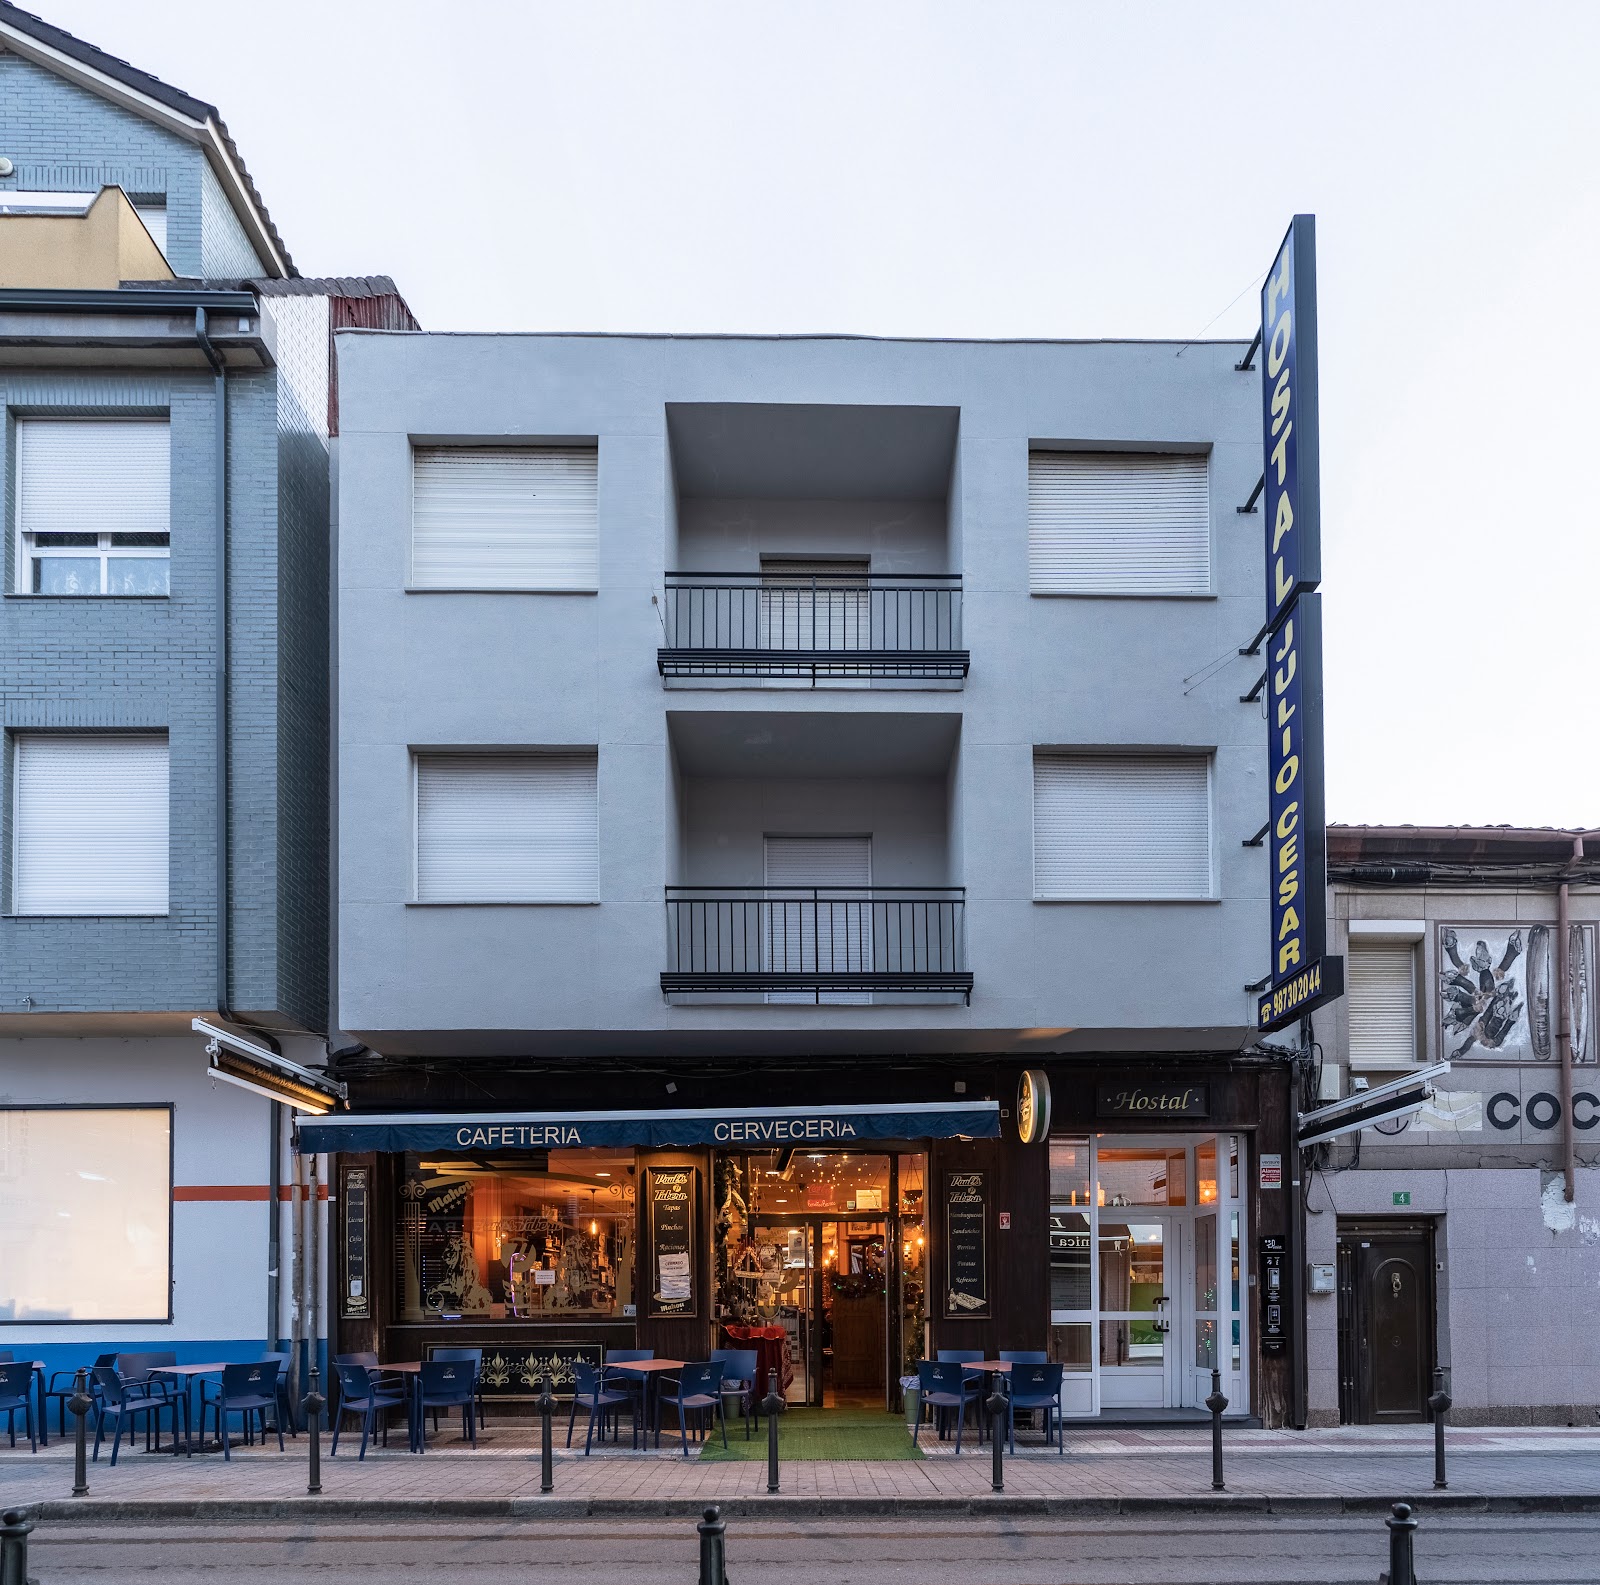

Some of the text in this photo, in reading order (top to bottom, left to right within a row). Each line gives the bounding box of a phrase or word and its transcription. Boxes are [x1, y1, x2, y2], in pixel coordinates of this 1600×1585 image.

[1267, 244, 1300, 975] HOSTAL JULIO CESAR
[1273, 965, 1321, 1017] 987302044
[1113, 1088, 1194, 1110] Hostal
[456, 1126, 582, 1147] CAFETERIA
[714, 1119, 857, 1141] CERVECERIA
[663, 1204, 681, 1212] Tapas
[1398, 1193, 1405, 1203] 4
